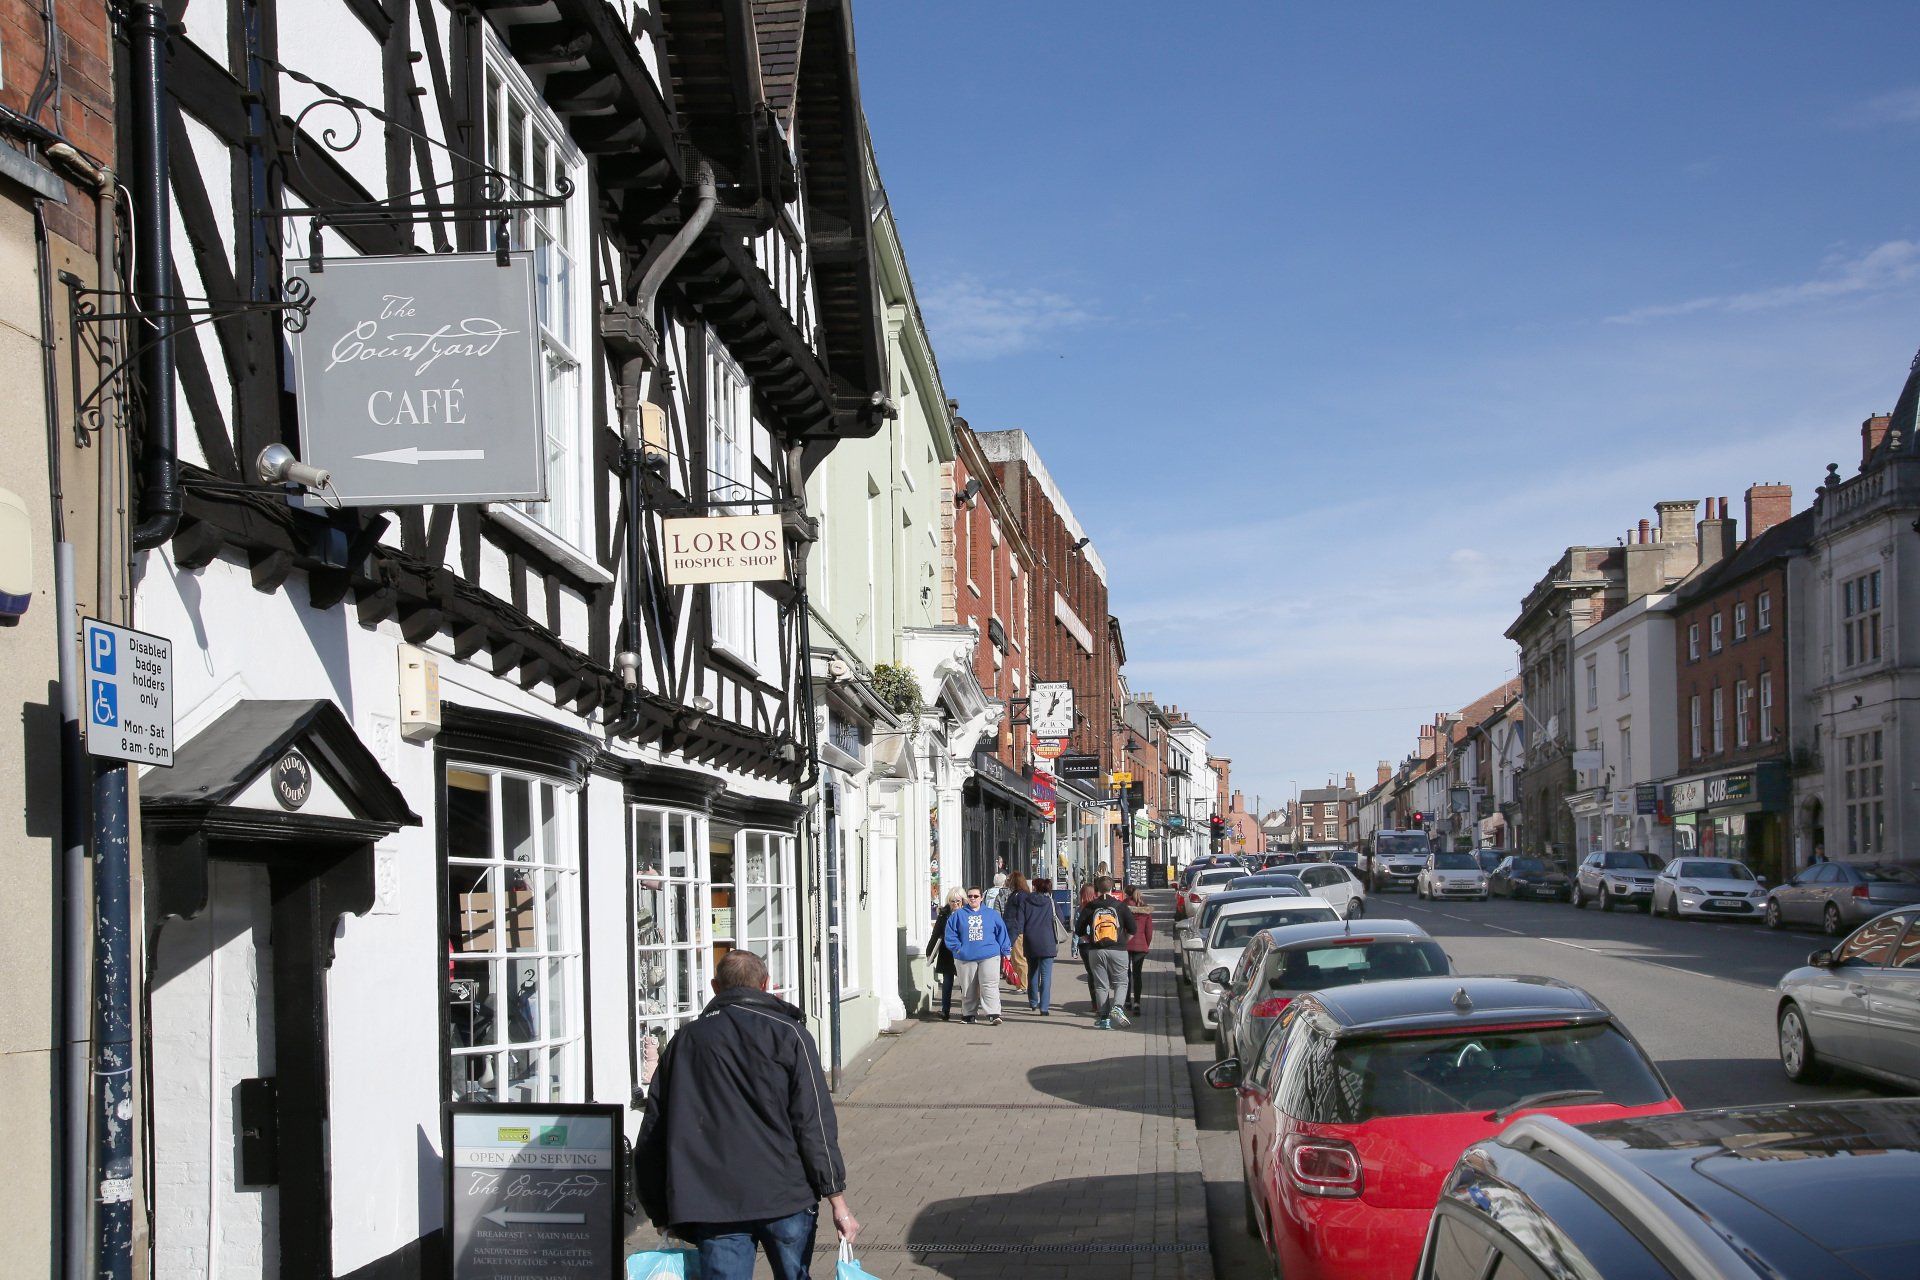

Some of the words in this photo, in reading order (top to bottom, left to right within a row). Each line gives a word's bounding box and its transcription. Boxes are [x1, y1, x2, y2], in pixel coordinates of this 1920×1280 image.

[380, 294, 417, 320] The
[325, 317, 521, 376] Courtyard
[367, 378, 467, 426] CAFÉ
[672, 530, 777, 553] LOROS
[674, 556, 735, 569] HOSPICE
[739, 555, 777, 567] SHOP
[94, 632, 112, 669] P
[129, 637, 167, 660] Disabled
[135, 656, 162, 675] badge
[132, 672, 165, 691] holders
[140, 692, 159, 709] only
[124, 719, 143, 735] Mon
[150, 724, 165, 739] Sat
[280, 757, 306, 778] TUDOR
[281, 781, 306, 801] COURT
[1707, 779, 1727, 803] SUB
[470, 1151, 505, 1163] OPEN
[508, 1153, 537, 1164] AND
[540, 1154, 597, 1165] SERVING
[468, 1170, 501, 1196] The
[503, 1174, 607, 1211] Courtyard
[477, 1230, 523, 1239] BREAKFAST
[537, 1231, 560, 1239] MAIN
[562, 1232, 590, 1240] MEALS
[473, 1257, 502, 1265] JACKET
[505, 1258, 548, 1266] POTATOES
[561, 1259, 593, 1267] SALADS
[474, 1247, 529, 1256] SANDWICHES
[542, 1249, 592, 1257] BAGUETTES
